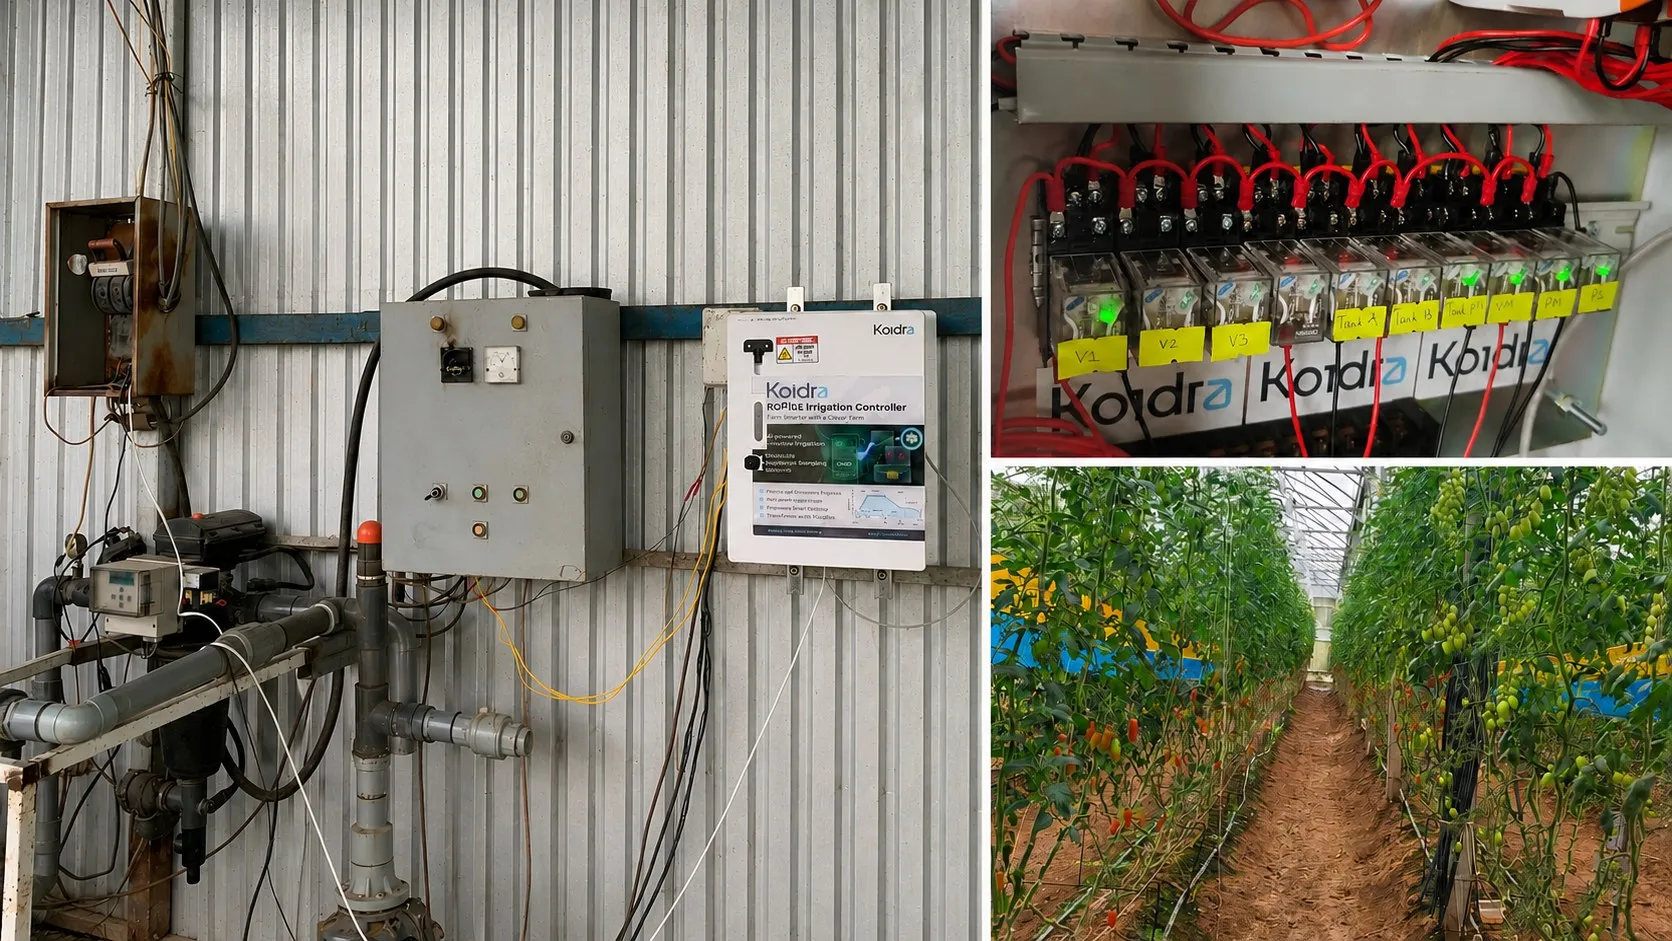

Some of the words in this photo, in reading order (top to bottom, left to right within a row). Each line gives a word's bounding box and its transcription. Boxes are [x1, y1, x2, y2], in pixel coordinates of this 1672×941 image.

[1337, 314, 1362, 330] Tank
[1367, 312, 1378, 326] A
[1393, 307, 1417, 326] Tank
[1424, 308, 1433, 320] B
[873, 324, 915, 336] Koidra
[1159, 338, 1178, 349] V2
[1229, 334, 1249, 348] V3
[1075, 350, 1101, 363] V1
[1260, 347, 1406, 402] Koidra
[766, 382, 828, 399] Koidra
[806, 403, 853, 413] Irrigation
[855, 403, 907, 412] Controller
[1052, 371, 1232, 432] Koidra
